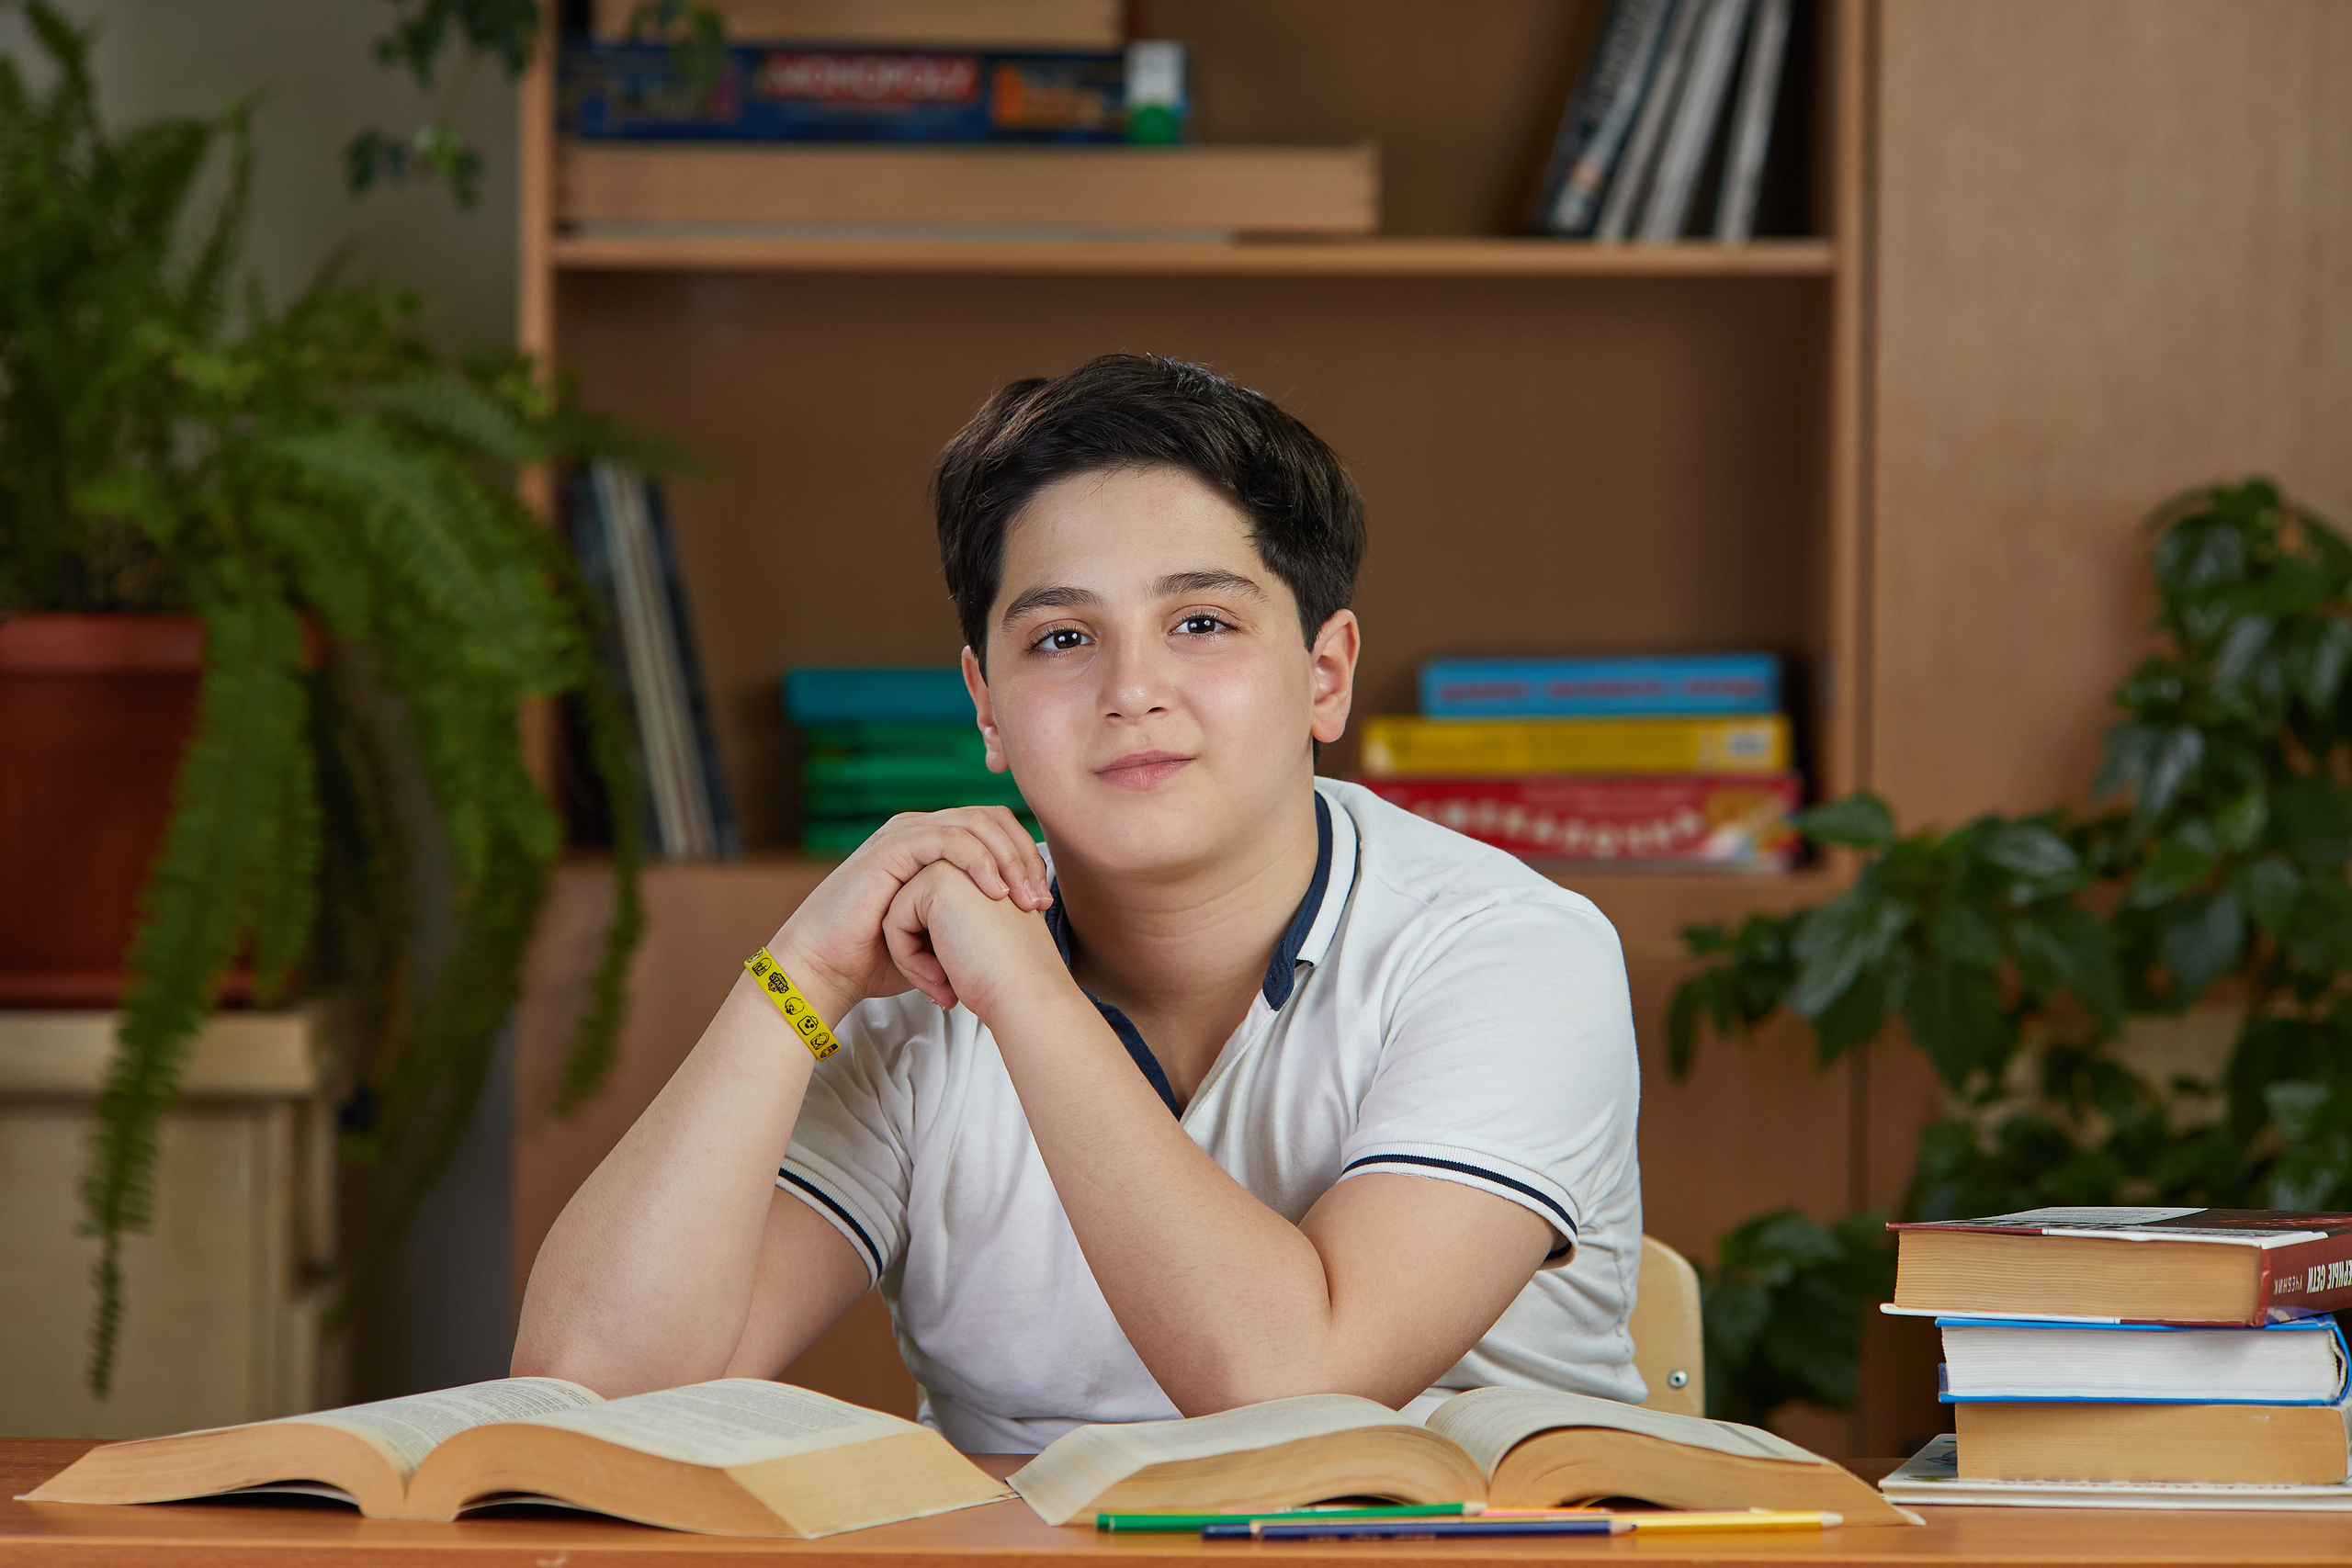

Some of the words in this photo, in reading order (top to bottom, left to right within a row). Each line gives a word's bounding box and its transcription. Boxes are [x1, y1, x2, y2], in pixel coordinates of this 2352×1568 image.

[772, 62, 971, 94] MONOPOLY
[770, 973, 788, 993] STARS
[2274, 1275, 2302, 1295] УЧЕБНИК
[2307, 1264, 2326, 1293] СЕТИ
